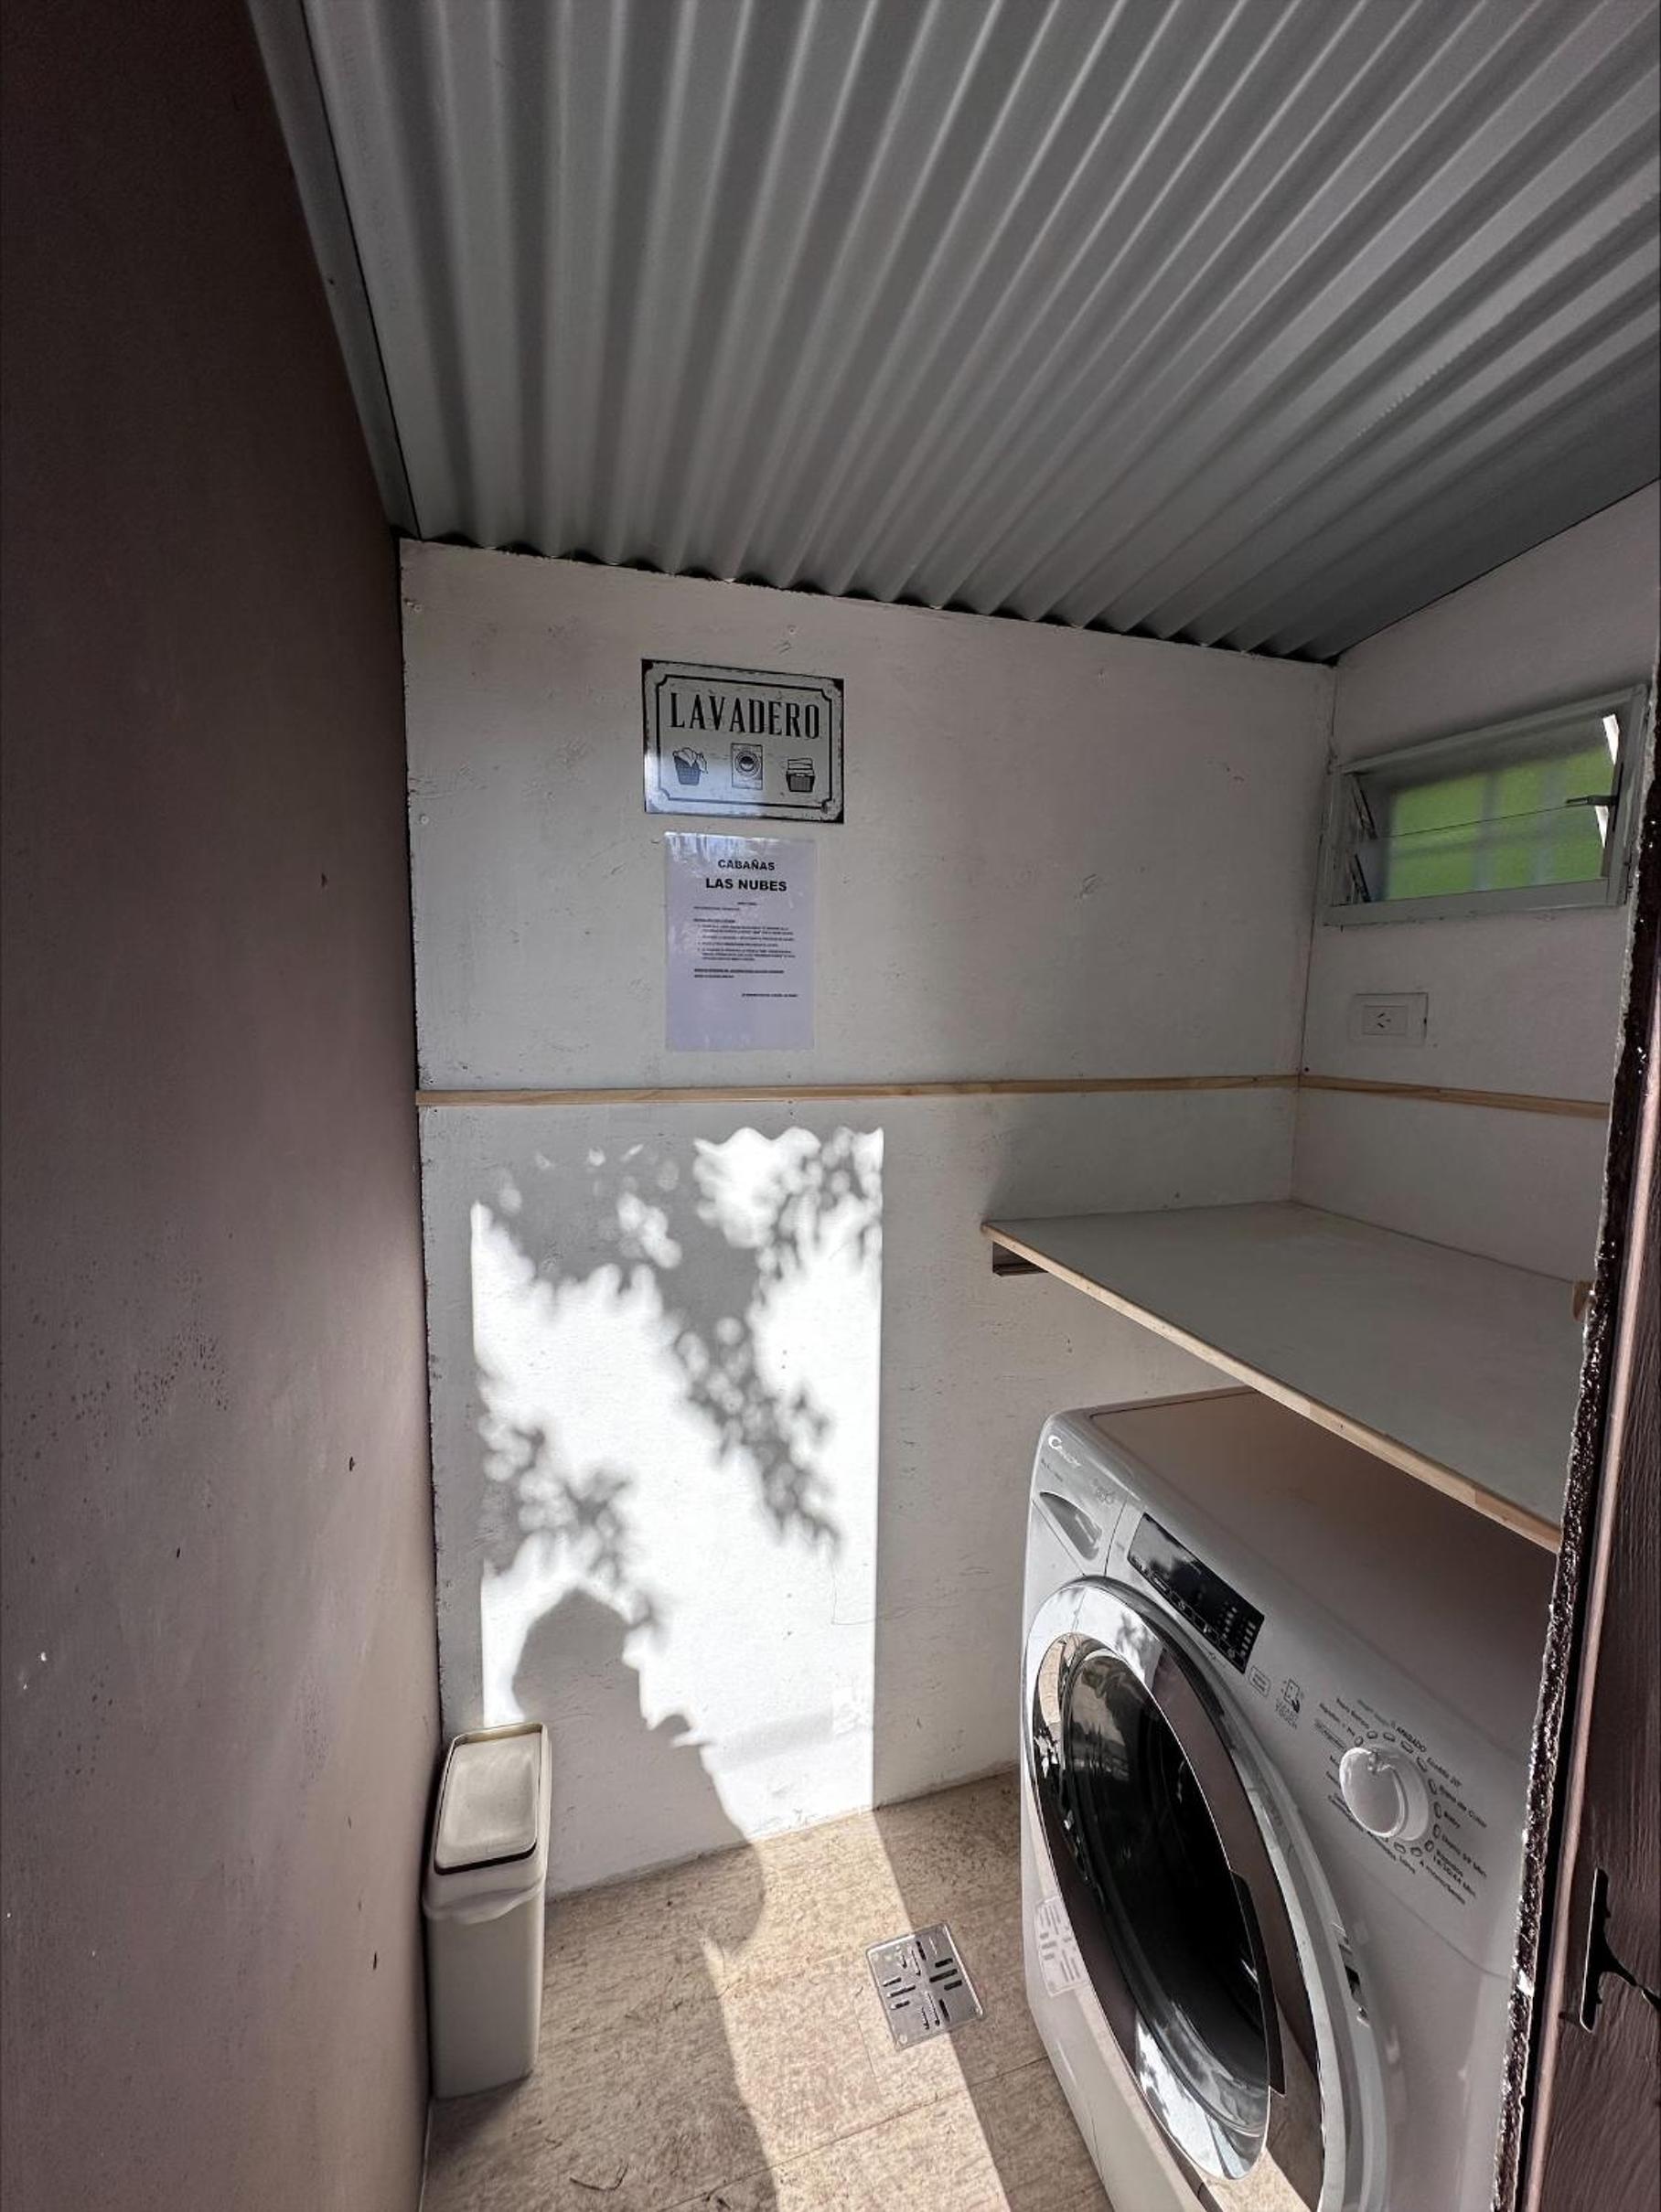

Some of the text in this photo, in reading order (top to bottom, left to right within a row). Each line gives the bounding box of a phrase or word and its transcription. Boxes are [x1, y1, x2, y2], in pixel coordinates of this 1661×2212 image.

[670, 692, 820, 739] LAVADERO
[718, 859, 776, 871] CABAÑAS
[705, 878, 788, 892] LAS NUBES
